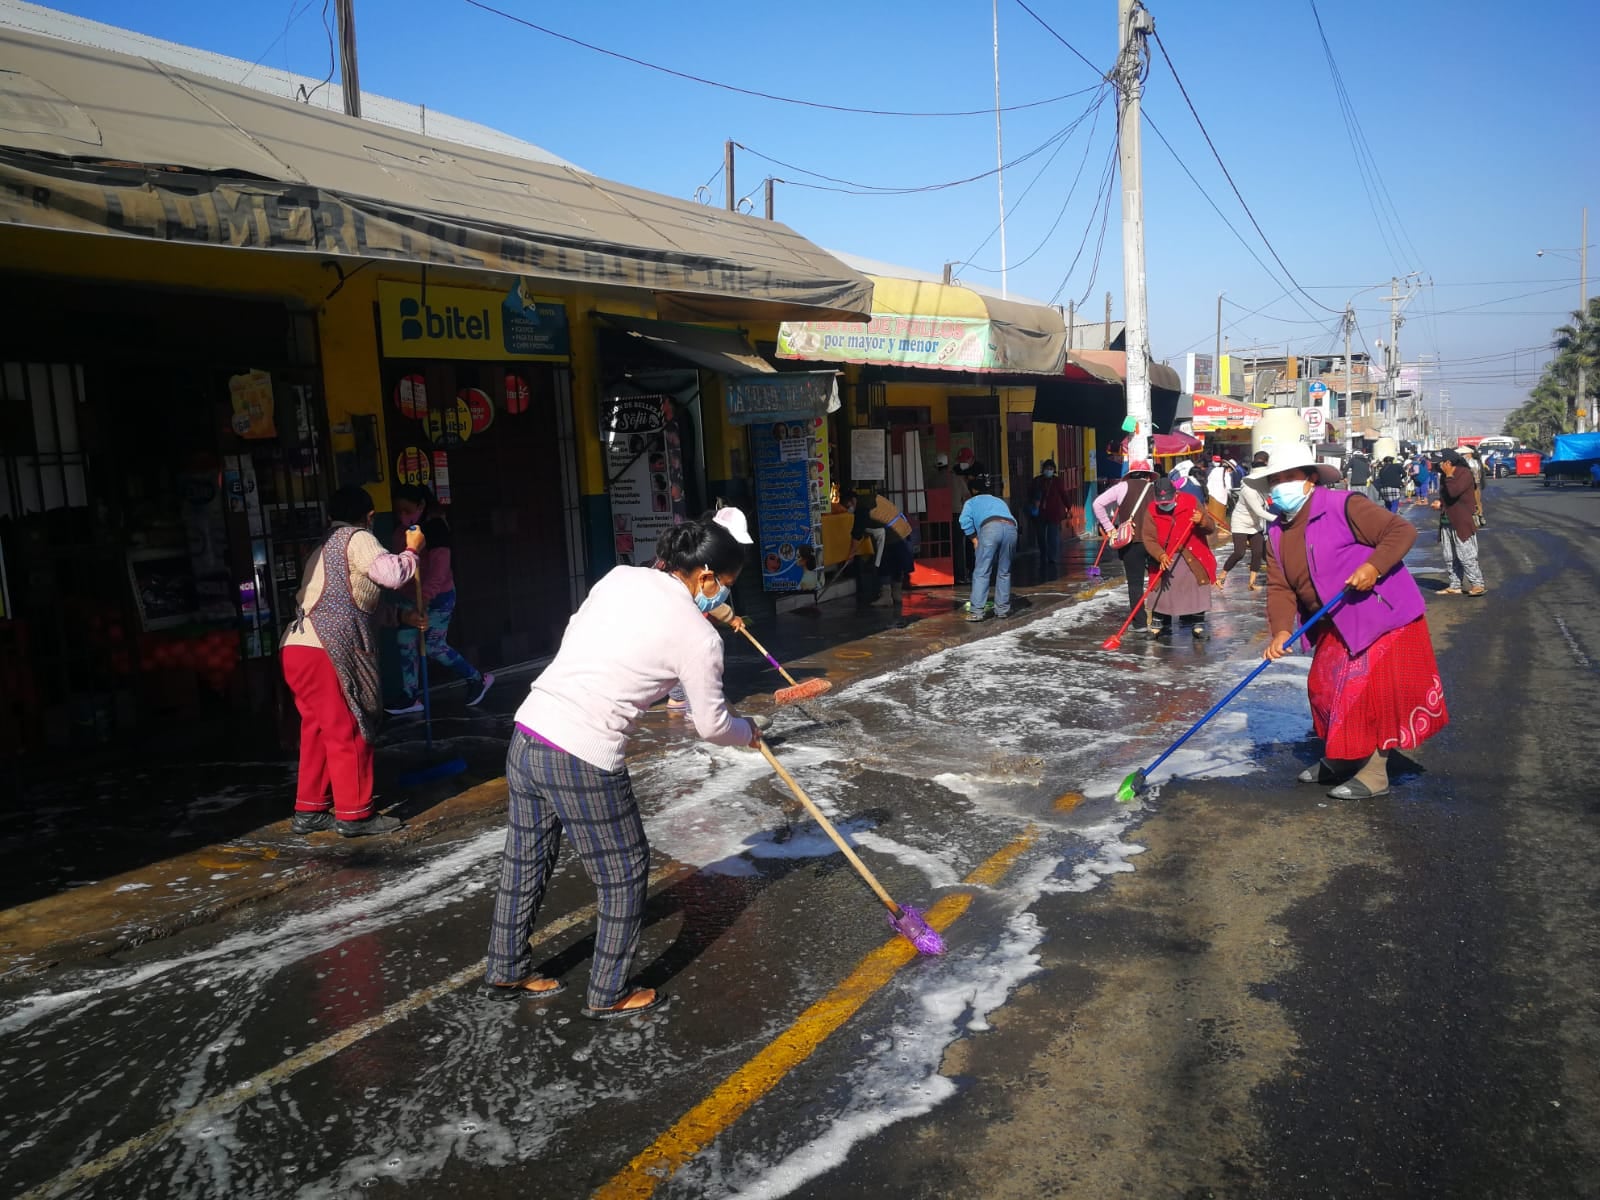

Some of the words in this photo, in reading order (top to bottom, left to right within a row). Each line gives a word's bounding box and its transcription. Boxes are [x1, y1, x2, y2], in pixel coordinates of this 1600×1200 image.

[425, 306, 491, 340] bitel
[867, 315, 891, 335] DE
[893, 317, 966, 342] POLLOS
[825, 334, 845, 351] por
[848, 335, 887, 353] mayor
[887, 338, 897, 353] y
[898, 338, 940, 354] menor
